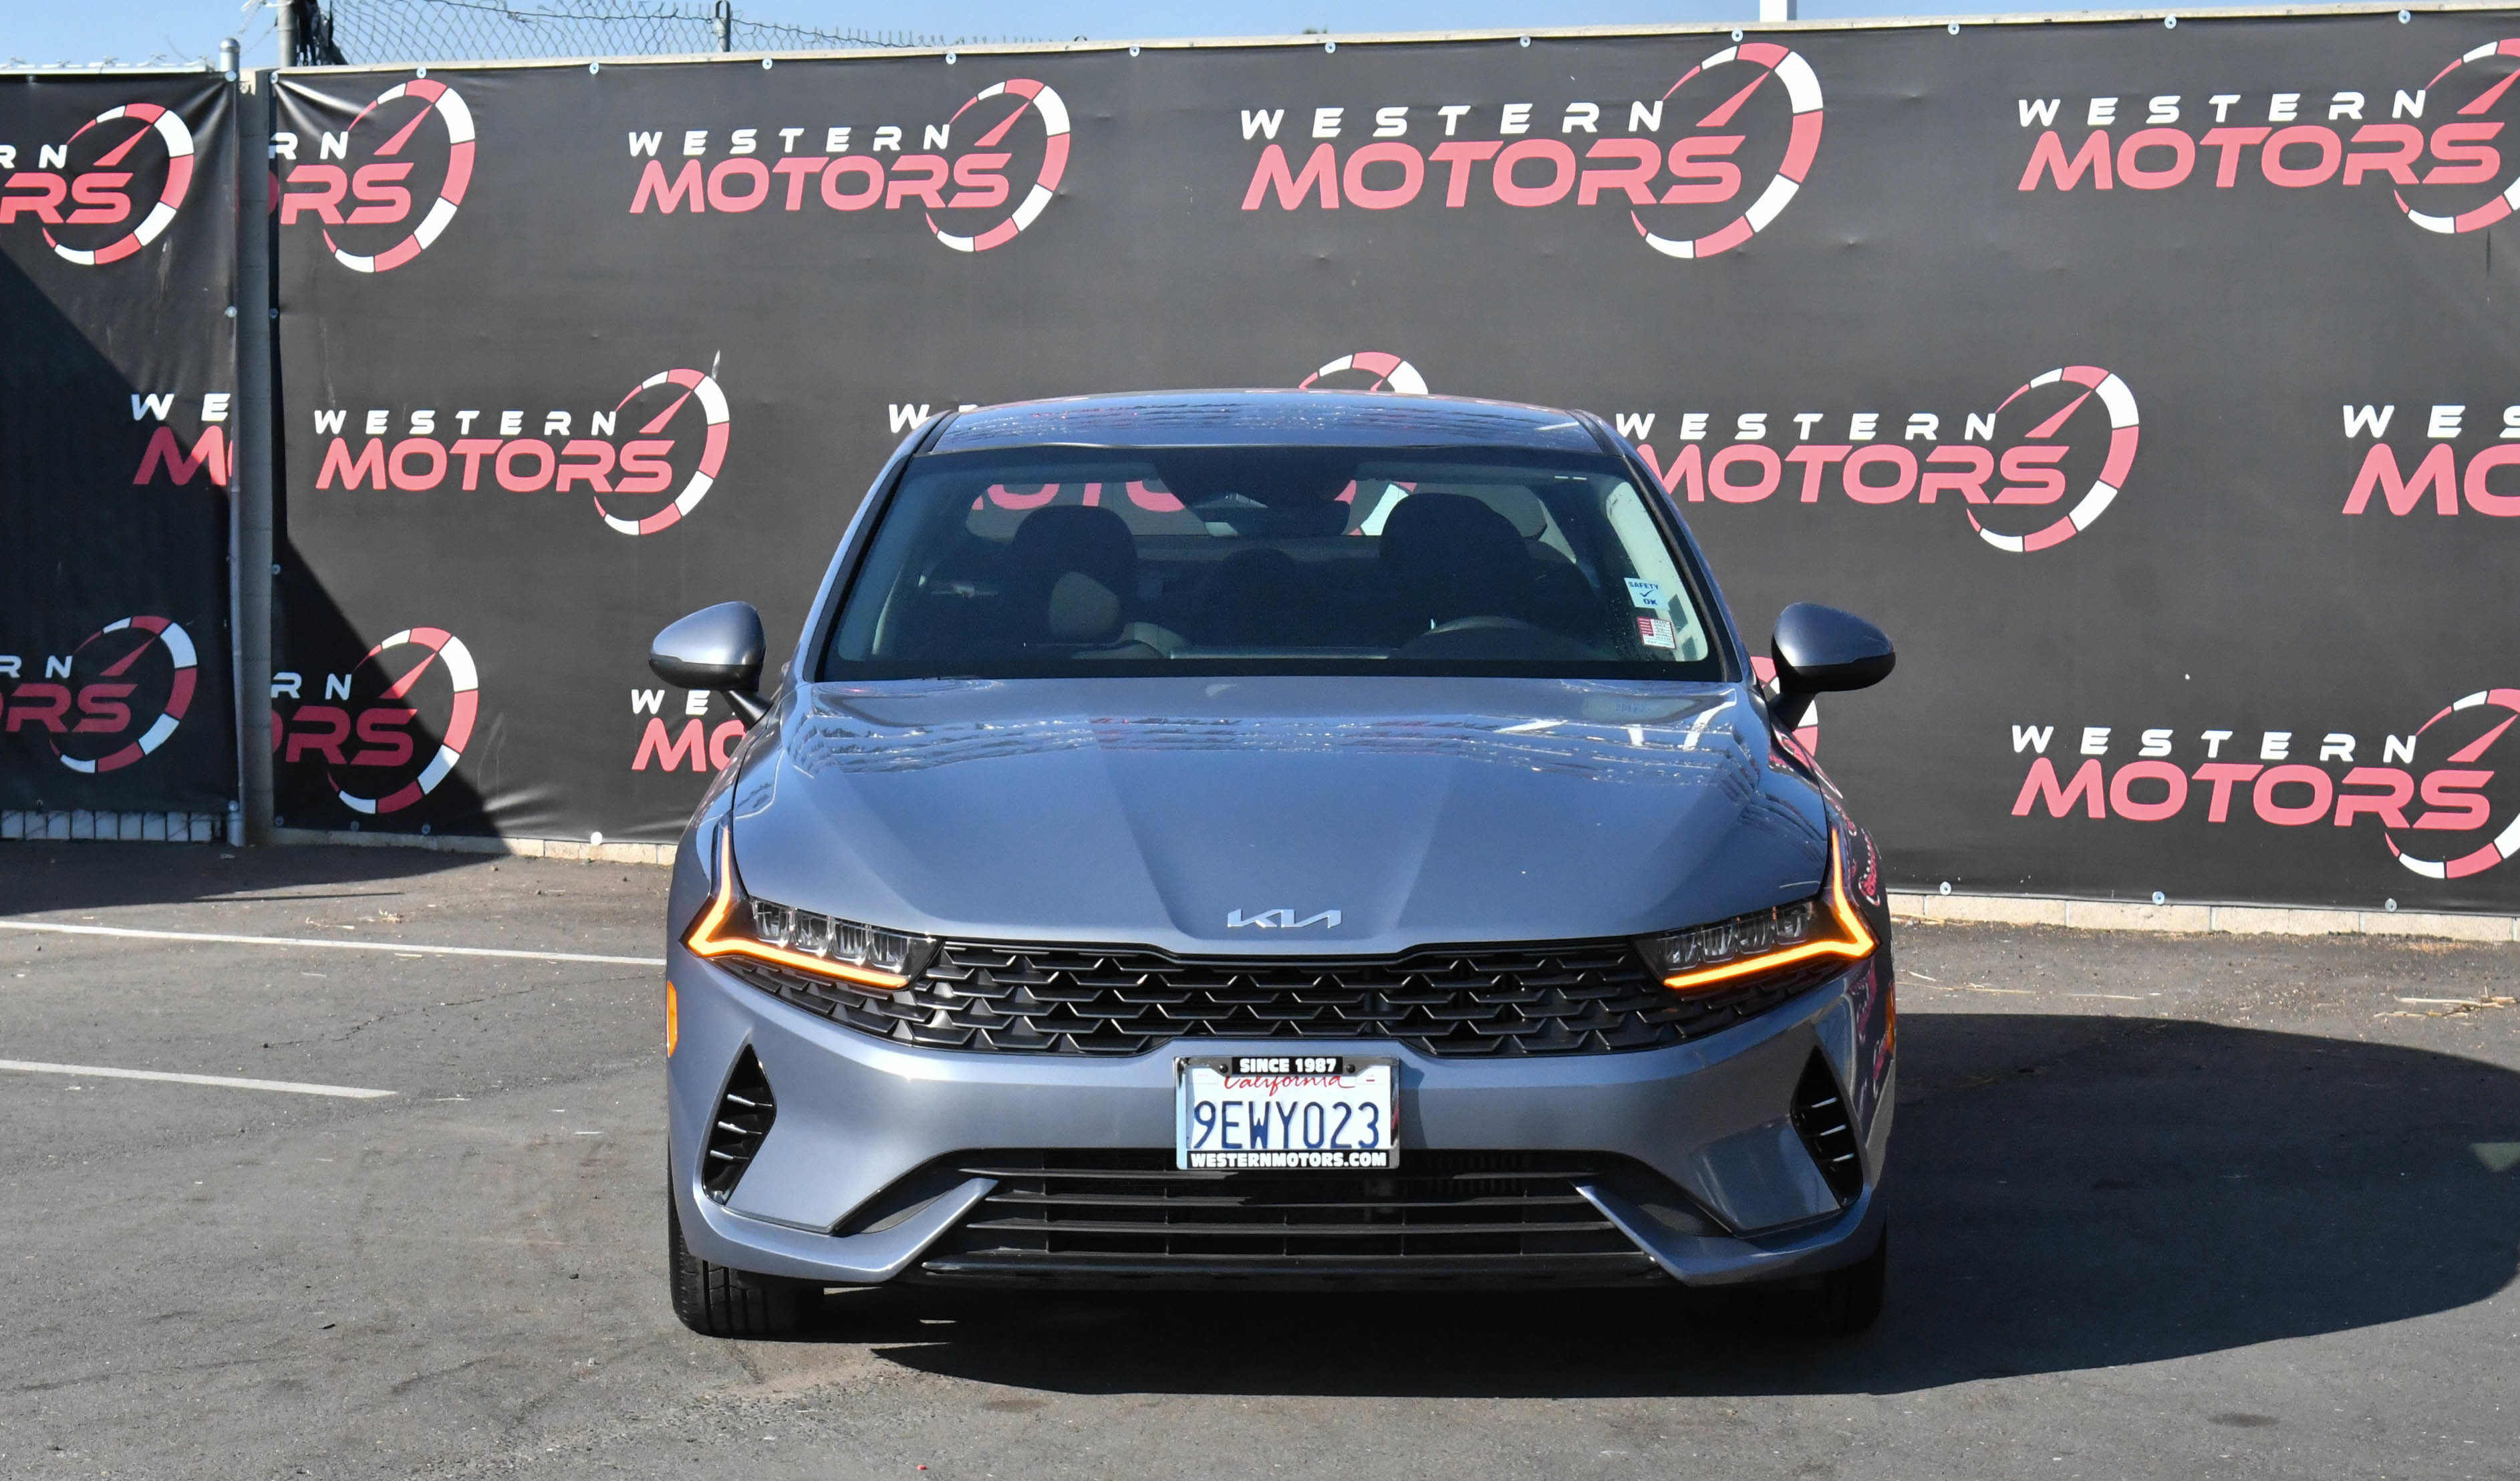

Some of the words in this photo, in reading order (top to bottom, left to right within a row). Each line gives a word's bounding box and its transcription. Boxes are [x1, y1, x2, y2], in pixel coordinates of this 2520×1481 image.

[1242, 100, 1663, 140] WESTERN
[2019, 90, 2426, 127] WESTERN
[629, 124, 950, 158] WESTERN
[2018, 122, 2505, 192] MOTORS
[269, 162, 414, 225] RS
[629, 152, 1012, 214] MOTORS
[1242, 135, 1745, 211] MOTORS
[314, 410, 617, 436] WESTERN
[1616, 413, 1996, 441] WESTERN
[315, 438, 676, 493] MOTORS
[1637, 444, 2070, 504] MOTORS
[271, 705, 418, 767] RS
[2012, 725, 2416, 764] WESTERN
[2011, 757, 2495, 831] MOTORS
[1239, 1058, 1290, 1073] SINCE
[1295, 1058, 1337, 1073] 1987
[1194, 1100, 1379, 1149] 9EWY023
[1190, 1153, 1387, 1168] WESTERNMOTORS.COM
